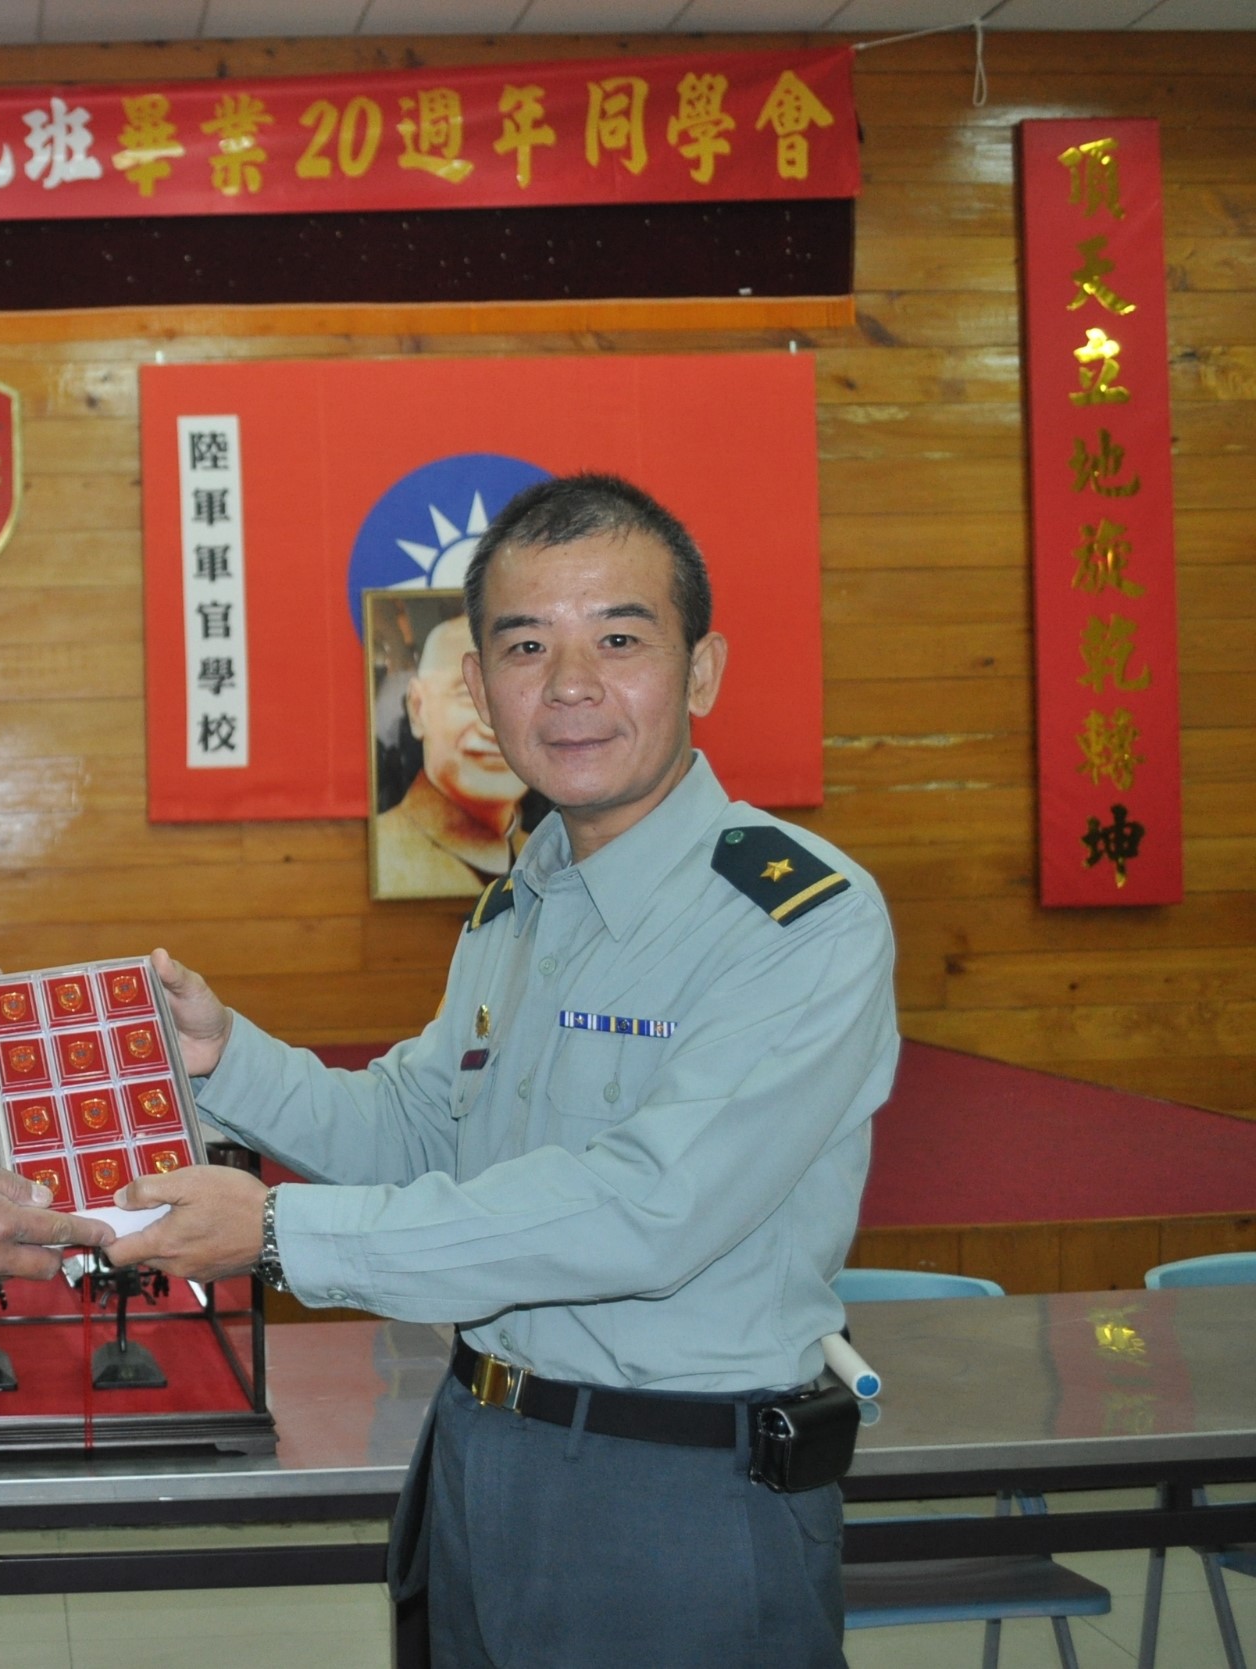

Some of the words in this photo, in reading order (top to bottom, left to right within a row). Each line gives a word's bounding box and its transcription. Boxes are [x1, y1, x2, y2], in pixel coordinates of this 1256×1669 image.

[189, 431, 238, 754] 陸軍軍官學校
[1057, 137, 1152, 888] 頂天立地旋乾轉坤
